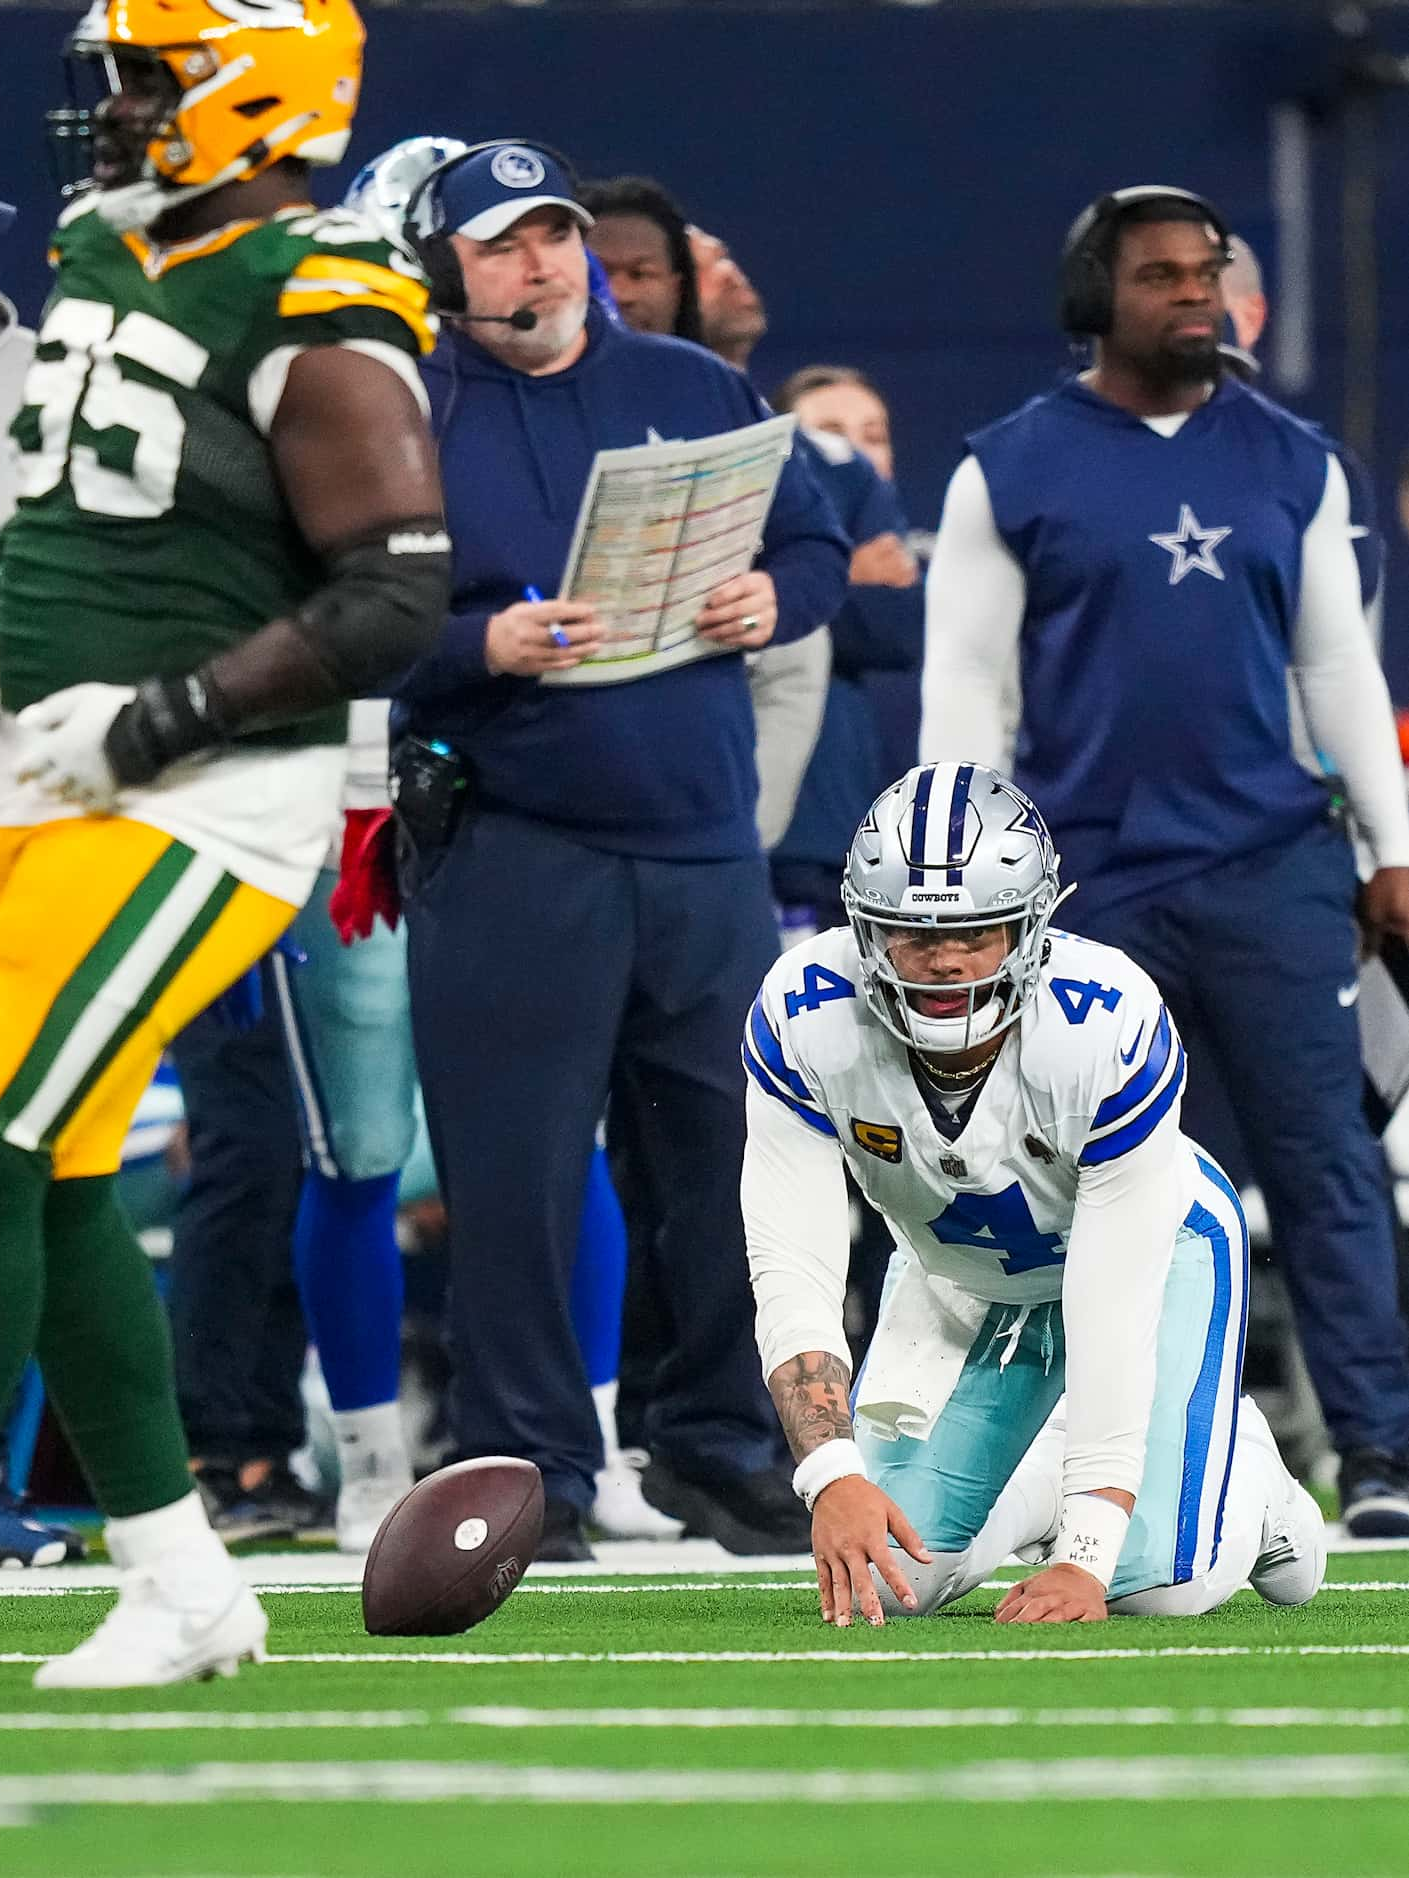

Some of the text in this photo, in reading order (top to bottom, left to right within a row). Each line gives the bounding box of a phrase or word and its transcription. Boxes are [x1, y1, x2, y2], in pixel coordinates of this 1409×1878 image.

[912, 893, 960, 903] COWBOYS
[784, 963, 857, 1019] 4
[1049, 977, 1123, 1025] 4
[854, 1121, 899, 1154] C
[925, 1180, 1067, 1276] 4
